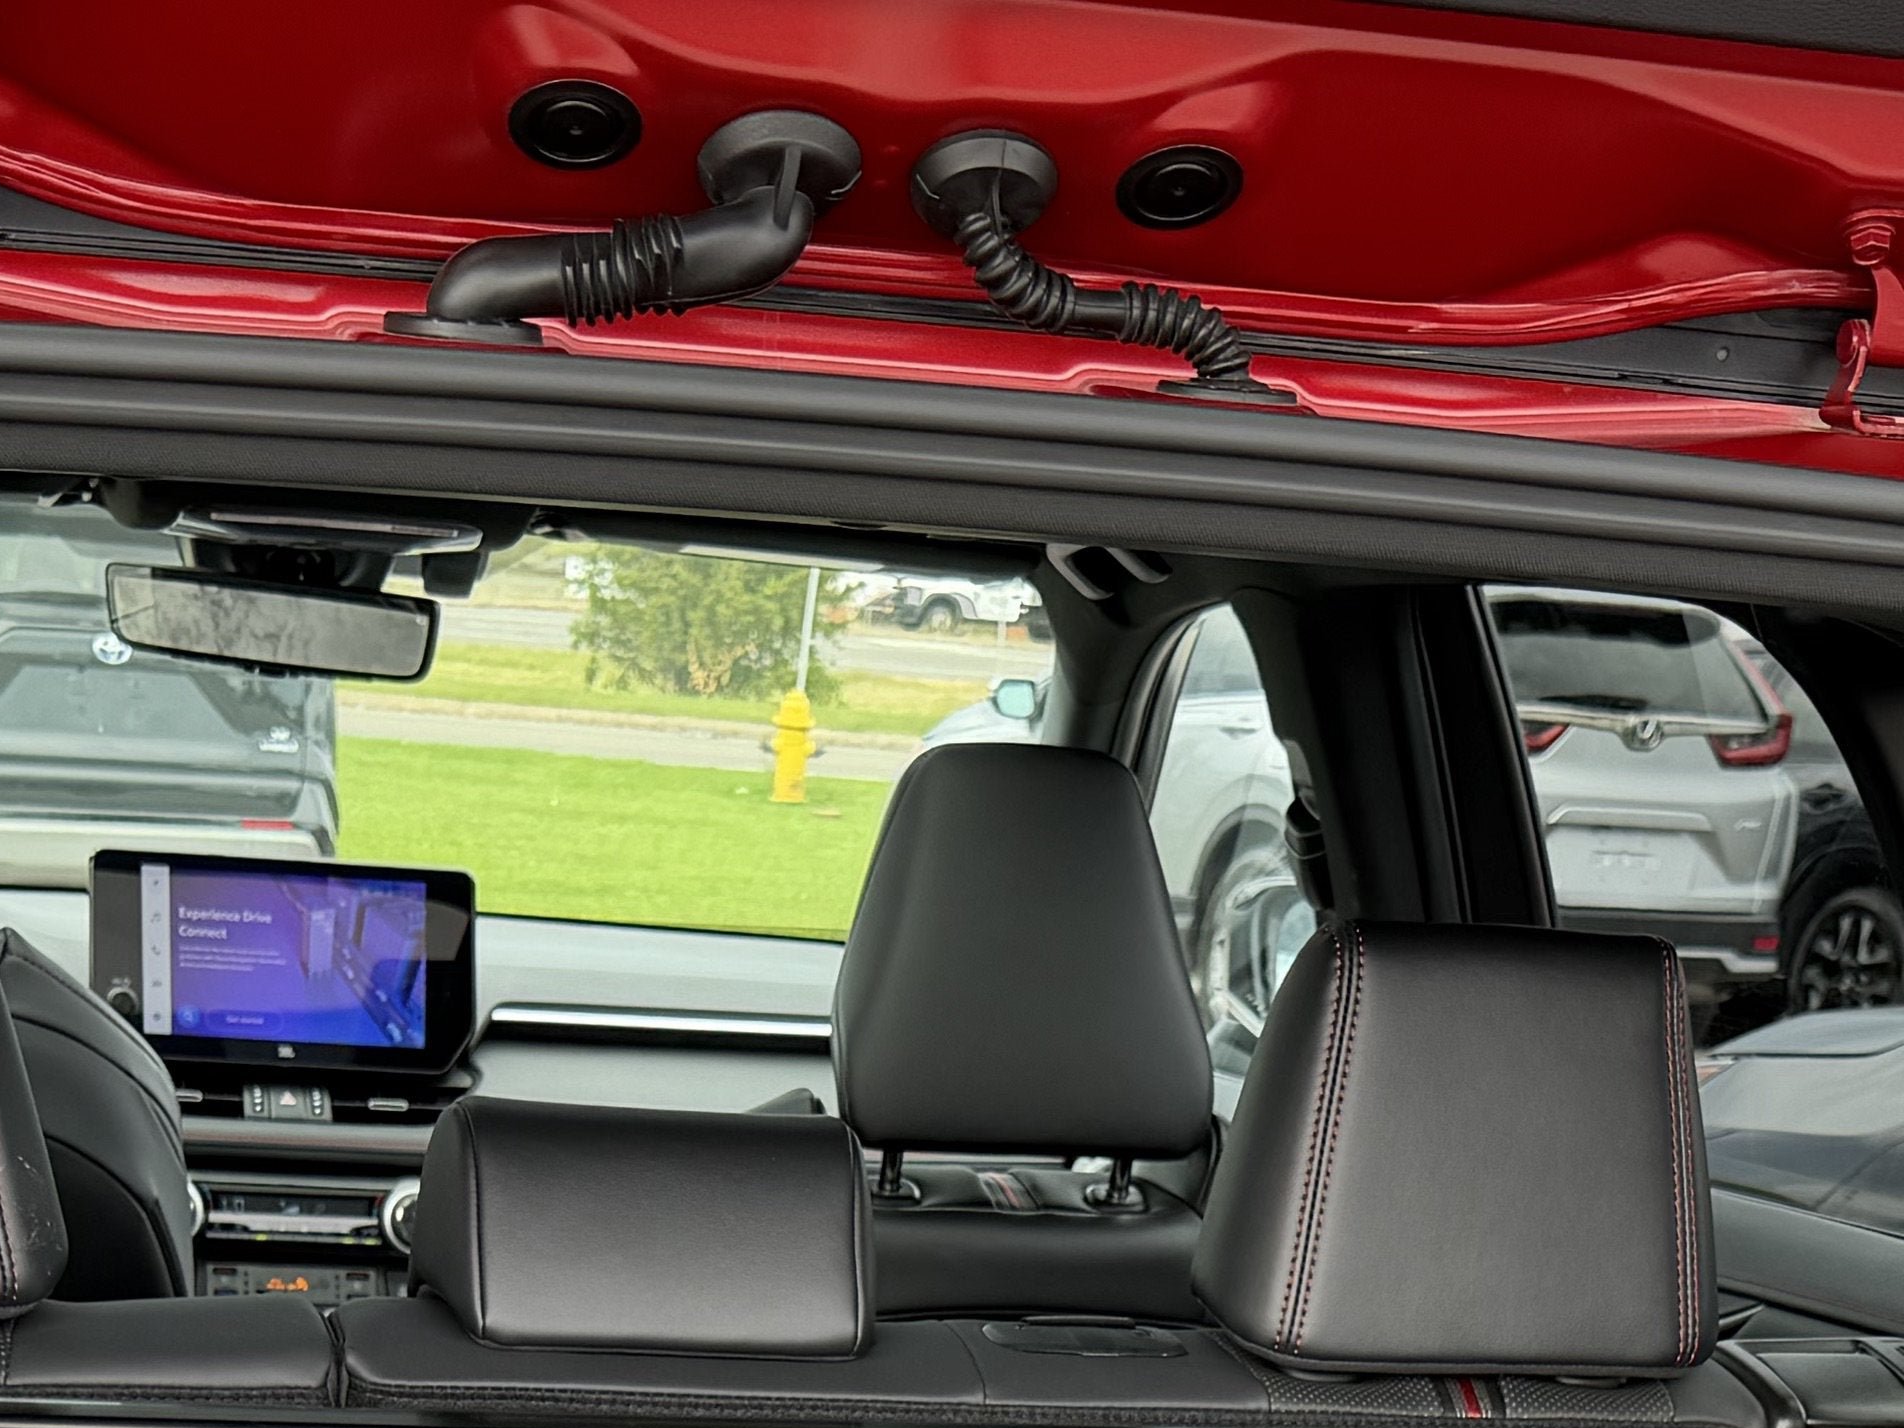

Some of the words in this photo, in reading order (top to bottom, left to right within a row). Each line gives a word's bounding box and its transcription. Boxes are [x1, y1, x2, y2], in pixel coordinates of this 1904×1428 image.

[178, 906, 240, 922] Experience
[242, 911, 272, 924] Drive
[178, 924, 228, 940] Connect
